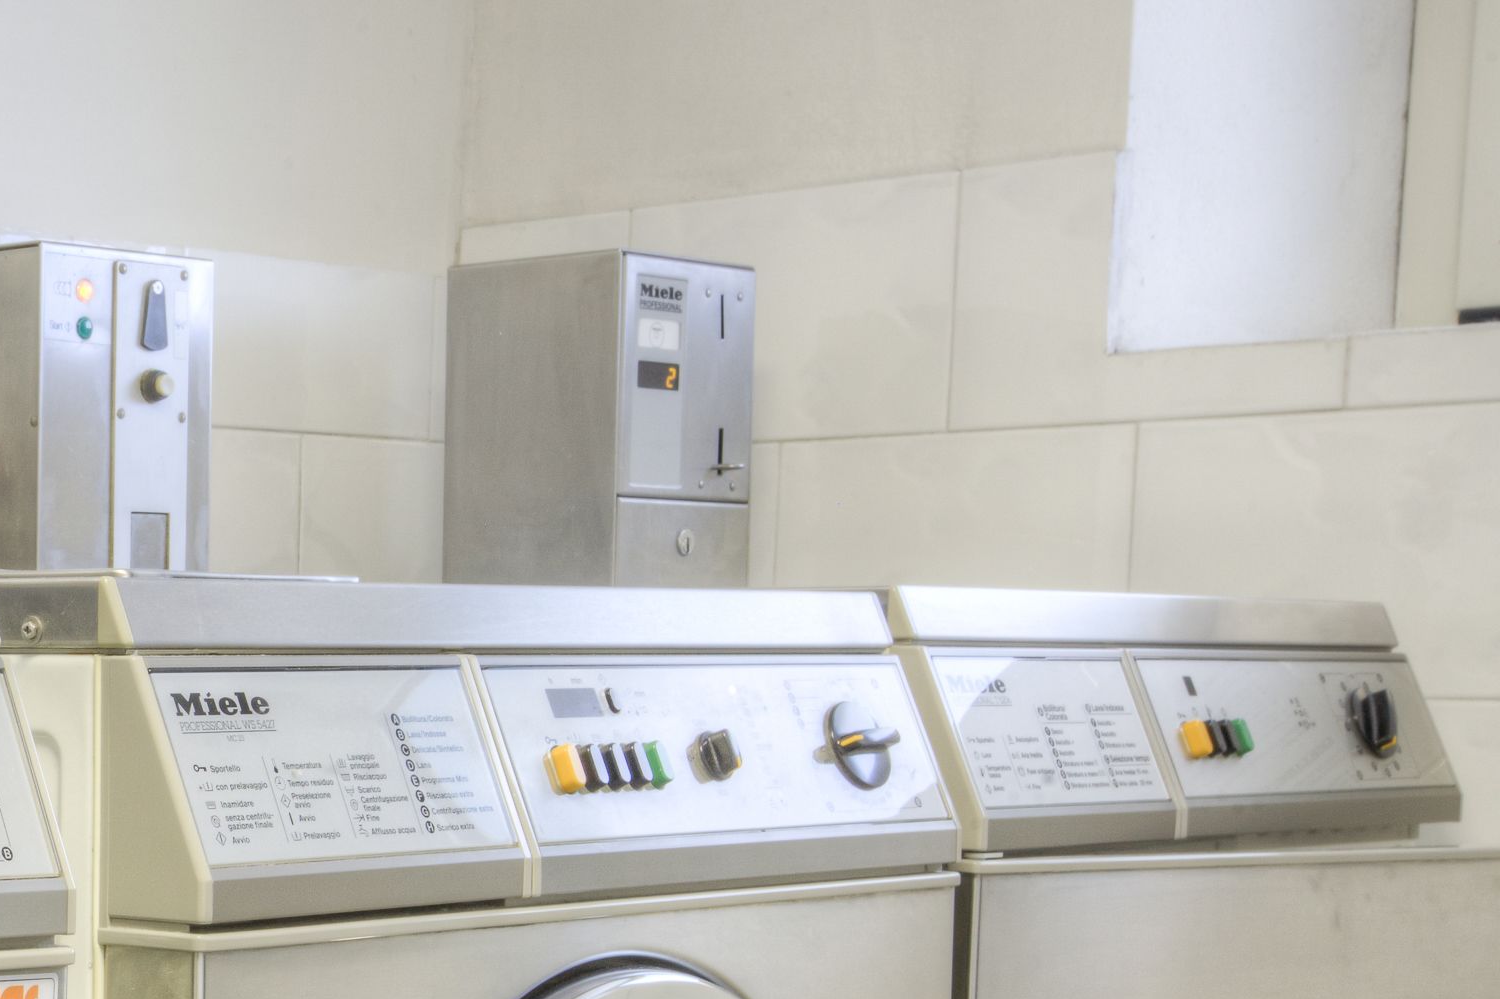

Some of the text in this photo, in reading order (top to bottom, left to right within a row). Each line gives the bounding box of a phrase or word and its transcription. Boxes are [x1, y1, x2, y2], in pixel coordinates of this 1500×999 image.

[640, 283, 682, 301] Miele
[640, 299, 681, 311] PROFESSIONAL
[665, 367, 677, 389] 2
[170, 692, 270, 717] Miele
[179, 719, 276, 731] PROFESSIONAL WS 5427
[347, 753, 375, 762] Lavaggio
[210, 764, 241, 774] Sportello
[282, 762, 322, 770] Temperatura
[350, 761, 380, 770] principale
[353, 773, 387, 781] Risciacquo
[421, 776, 454, 784] Programma
[230, 782, 268, 792] prelavaggio
[288, 778, 334, 788] Tempo residuo
[292, 792, 331, 800] Preselezione
[361, 795, 409, 804] Centrifugazione
[426, 791, 458, 800] Risciacquo
[221, 800, 254, 809] Inamidare
[363, 804, 381, 812] finale
[431, 807, 478, 815] Centrifugazione
[225, 813, 274, 822] senza centrifu-
[228, 821, 274, 831] gazione finale
[304, 831, 341, 840] Prelavaggio
[371, 827, 397, 835] Afflusso
[232, 836, 250, 844] Avvio
[1, 847, 13, 861] B
